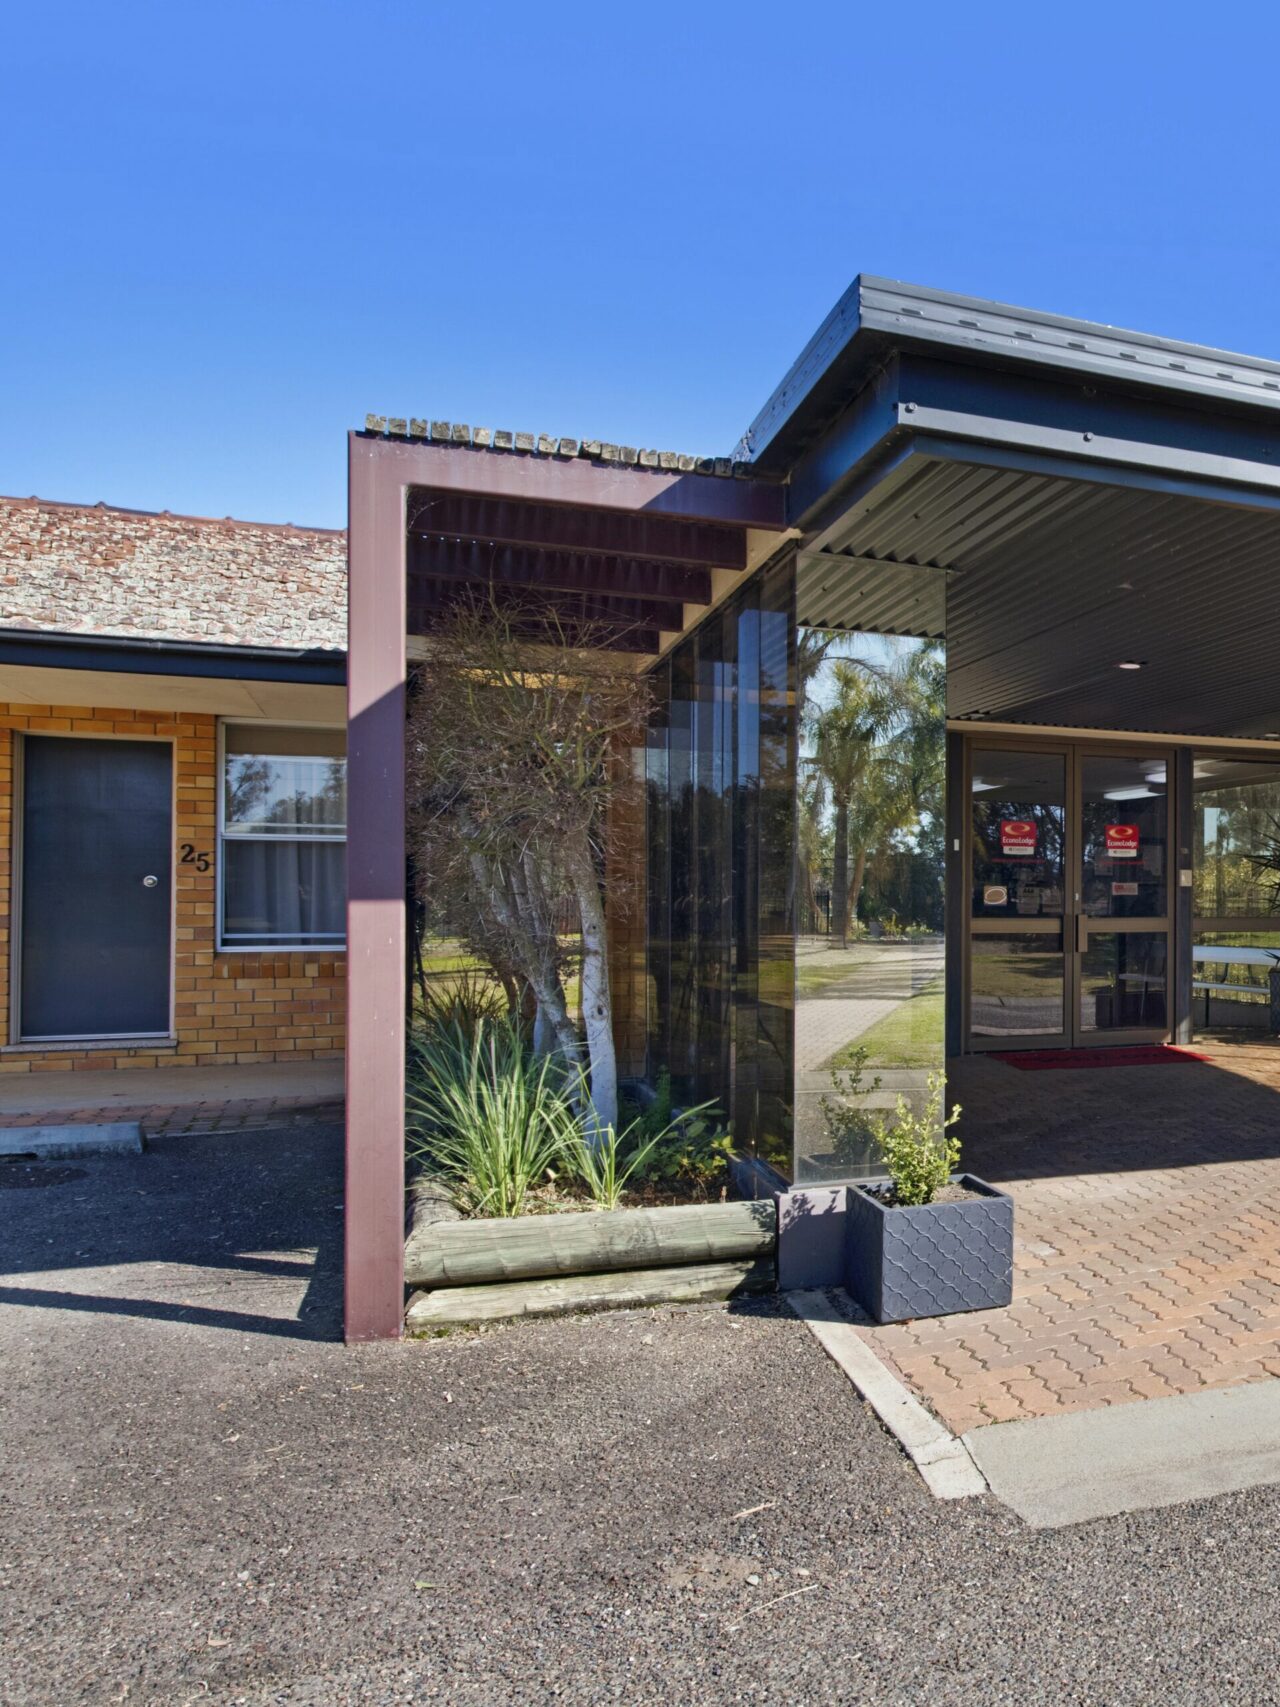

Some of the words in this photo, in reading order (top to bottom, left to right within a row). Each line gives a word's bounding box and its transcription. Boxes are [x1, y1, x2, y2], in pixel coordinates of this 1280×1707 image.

[1003, 836, 1034, 845] EconoLodge
[1107, 839, 1137, 848] EconoLodge
[180, 843, 209, 872] 25
